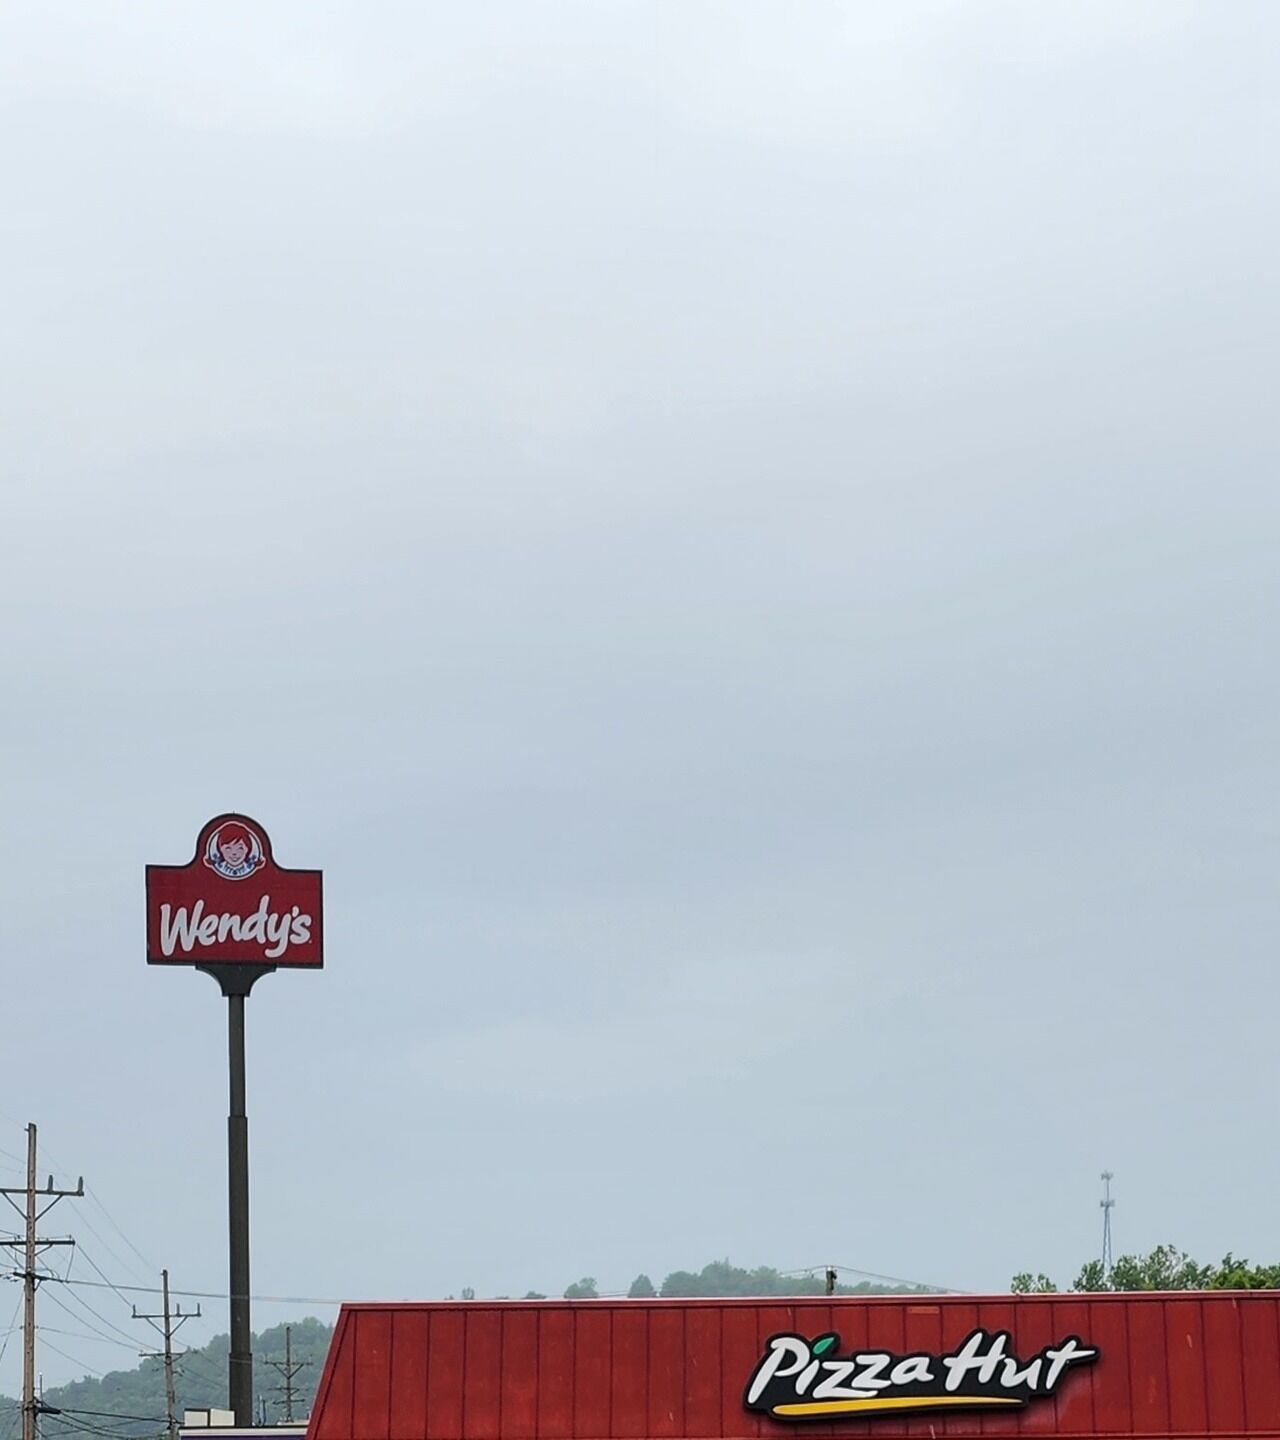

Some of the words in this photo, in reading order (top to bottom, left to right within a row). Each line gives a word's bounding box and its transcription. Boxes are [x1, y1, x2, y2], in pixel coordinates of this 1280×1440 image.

[160, 895, 312, 958] Wendy's
[748, 1337, 935, 1404] Pizza
[943, 1332, 1096, 1391] Hut
